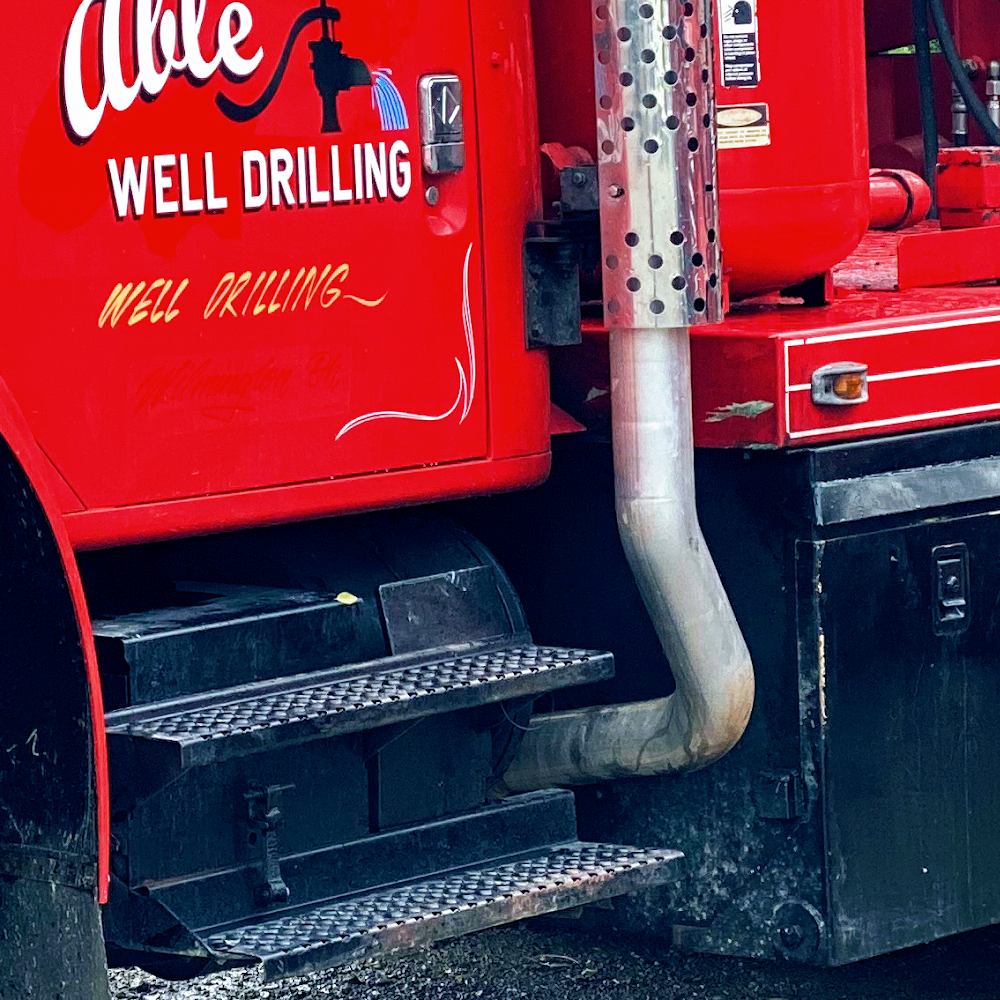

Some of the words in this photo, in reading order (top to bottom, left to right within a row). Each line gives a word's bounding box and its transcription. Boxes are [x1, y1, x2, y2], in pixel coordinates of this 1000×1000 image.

[107, 151, 229, 221] WELL
[242, 139, 413, 212] DRILLING
[98, 277, 190, 329] WELL
[203, 263, 387, 320] DRILLING
